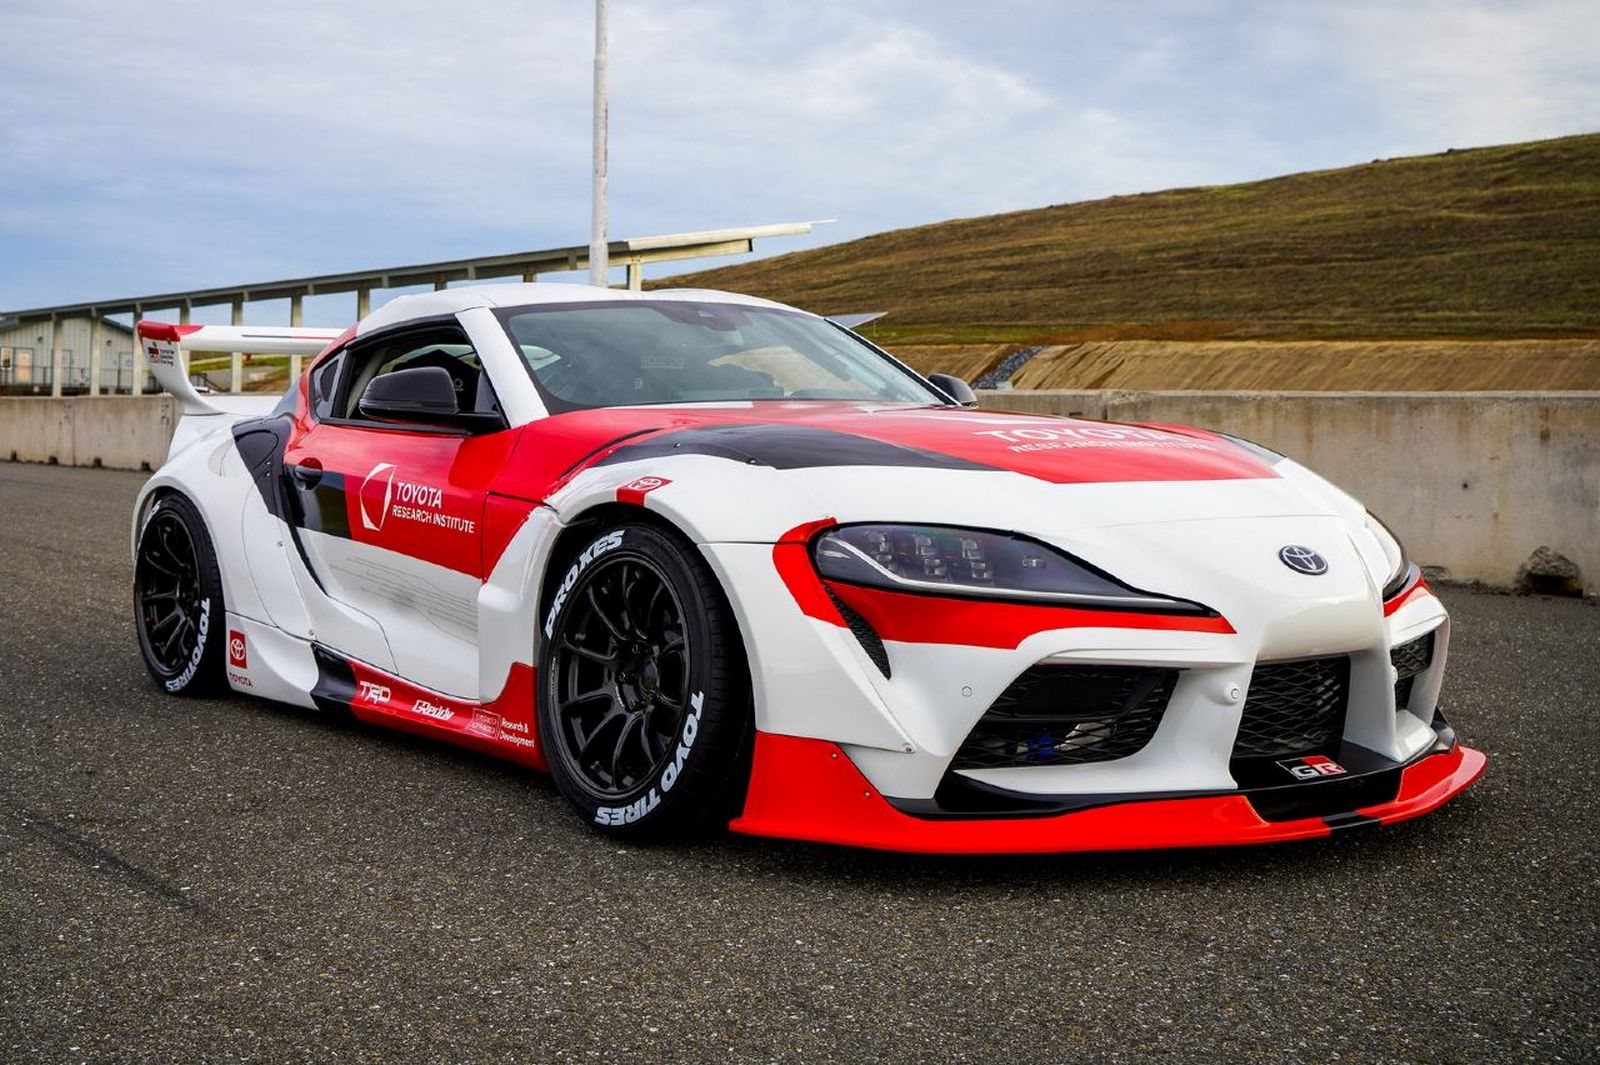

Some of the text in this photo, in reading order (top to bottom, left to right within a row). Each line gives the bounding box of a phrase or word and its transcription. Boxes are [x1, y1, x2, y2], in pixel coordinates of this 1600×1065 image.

[972, 428, 1190, 443] TOYOTA
[396, 482, 442, 509] TOYOTA
[391, 504, 476, 534] RESEARCH INSTITUTE
[545, 530, 625, 640] PROXES
[165, 597, 210, 692] TOYO TIRES
[229, 672, 254, 688] TOYOTA
[359, 680, 392, 704] TRD
[501, 717, 524, 732] Research
[499, 730, 535, 748] Development
[594, 690, 704, 826] TOYO TIRES
[1291, 763, 1345, 777] GR
